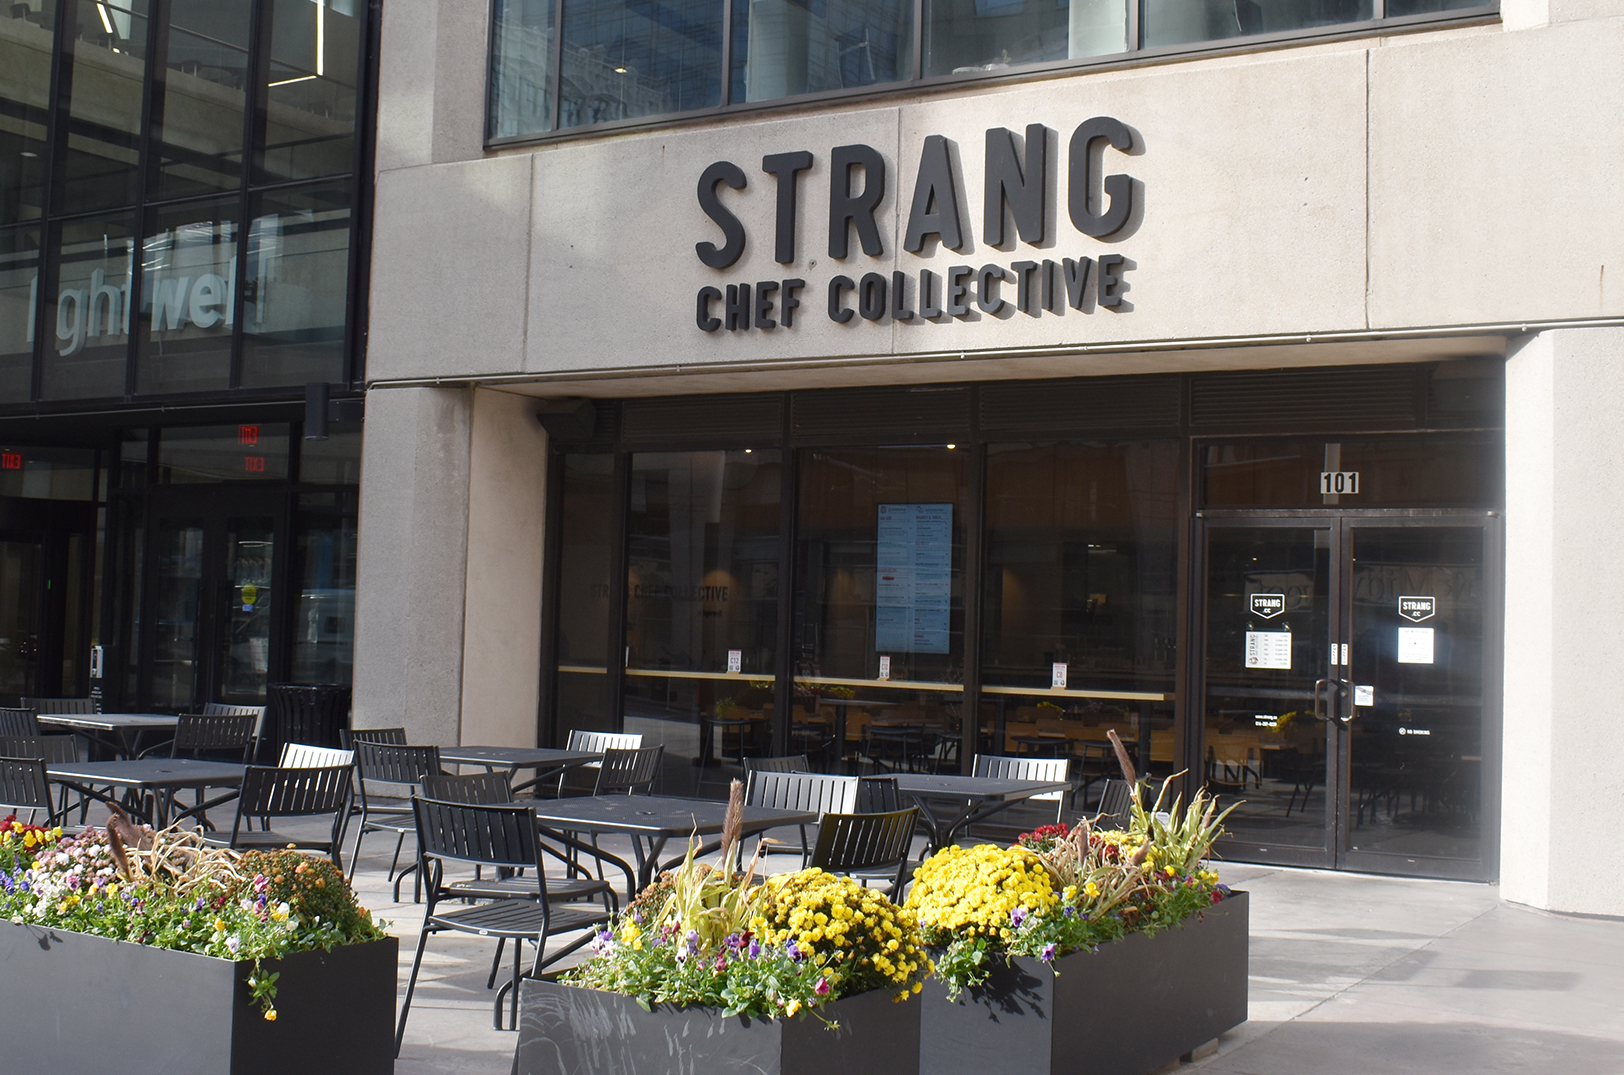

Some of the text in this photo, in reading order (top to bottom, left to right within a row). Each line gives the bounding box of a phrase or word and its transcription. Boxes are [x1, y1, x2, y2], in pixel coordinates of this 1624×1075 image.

[695, 116, 1134, 269] STRANG
[696, 254, 1125, 332] CHEF COLLECTIVE
[1323, 472, 1357, 493] 101
[1254, 599, 1281, 608] STRANG
[1402, 601, 1431, 611] STRANG
